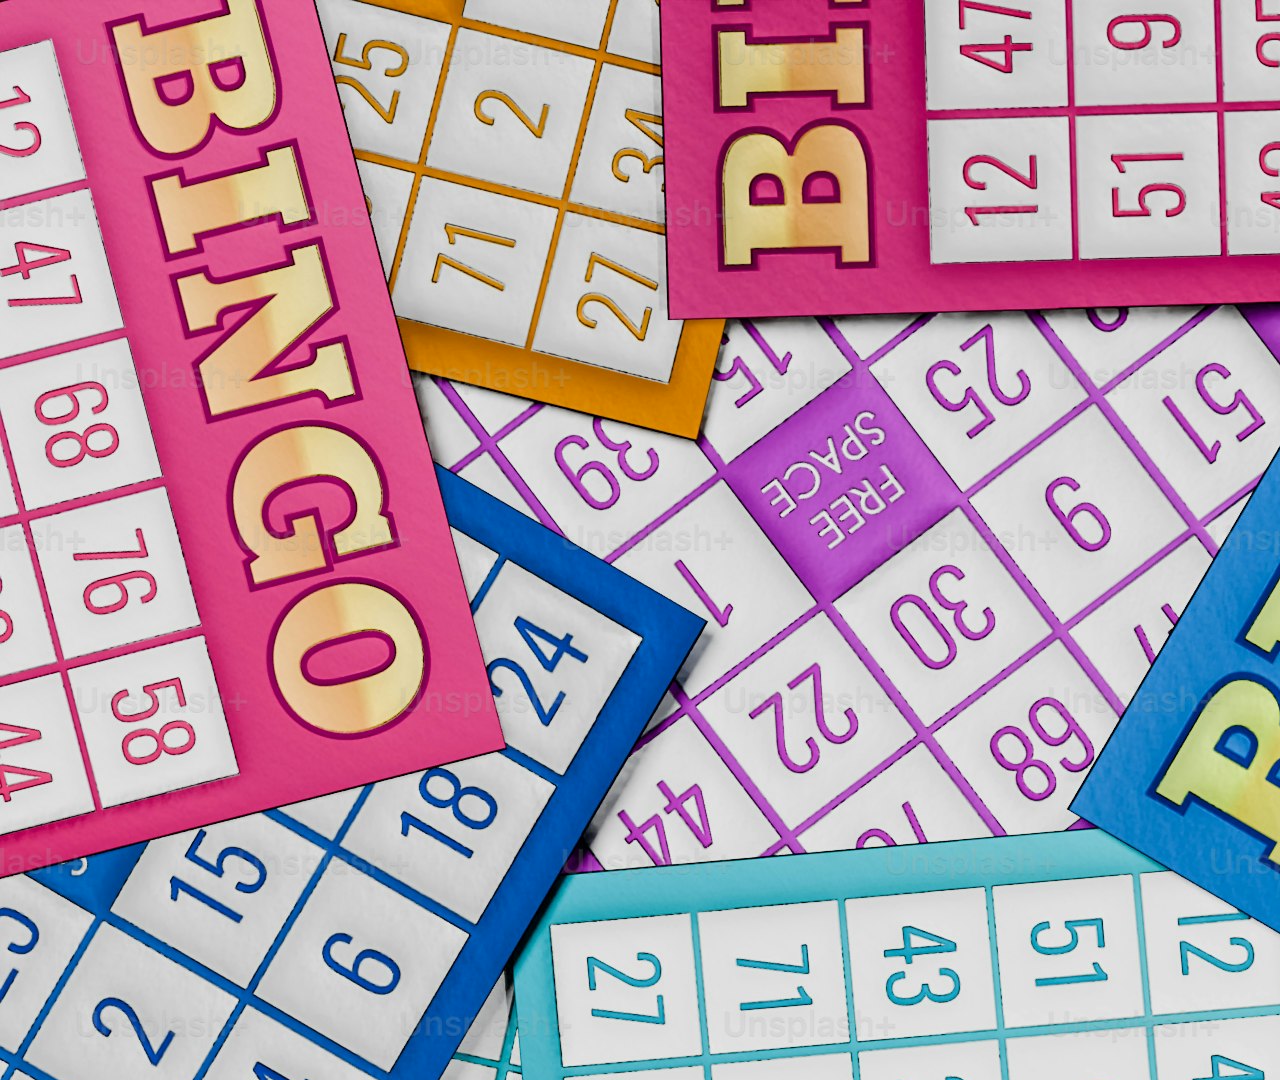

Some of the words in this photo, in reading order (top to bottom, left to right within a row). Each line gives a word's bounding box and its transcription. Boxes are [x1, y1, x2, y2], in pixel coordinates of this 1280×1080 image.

[963, 155, 1038, 225] 12
[1111, 153, 1186, 217] 51
[0, 241, 82, 306] 47
[432, 224, 516, 291] 71
[576, 252, 658, 342] 27
[106, 0, 431, 740] BINGO
[926, 324, 1031, 438] 25
[1163, 363, 1265, 464] 51
[35, 381, 119, 468] 68
[554, 415, 660, 512] 39
[761, 412, 886, 518] SPACE
[810, 465, 905, 550] FREE
[1045, 477, 1111, 551] 9
[73, 528, 157, 614] 76
[890, 565, 995, 669] 30
[487, 616, 588, 727] 24
[111, 677, 196, 765] 58
[749, 663, 858, 773] 22
[990, 697, 1094, 801] 68
[400, 767, 499, 860] 18
[170, 829, 267, 923] 15
[736, 944, 813, 1010] 71
[1031, 918, 1108, 987] 51
[92, 998, 175, 1066] 2
